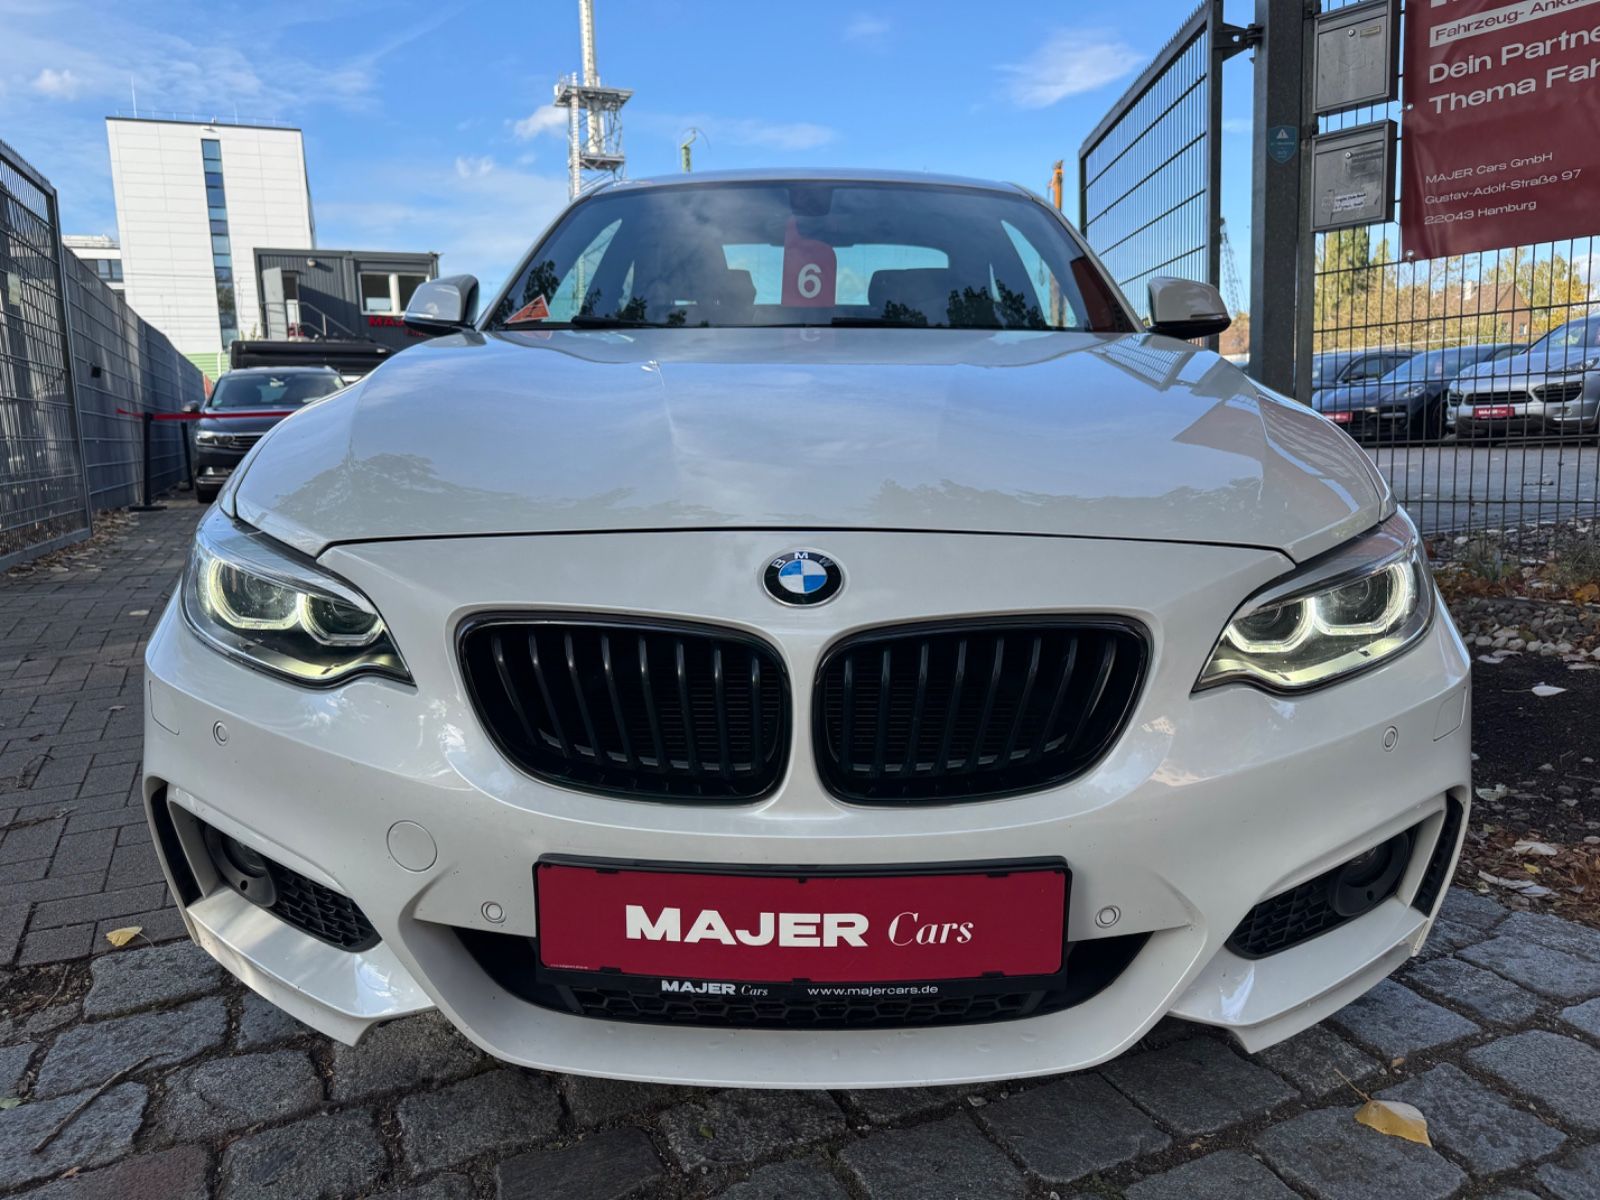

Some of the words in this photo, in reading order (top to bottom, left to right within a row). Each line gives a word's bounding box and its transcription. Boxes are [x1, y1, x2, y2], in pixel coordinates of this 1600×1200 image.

[1435, 11, 1525, 41] Fahrzeug-
[1429, 54, 1492, 84] Dein
[1428, 77, 1536, 114] Thema
[1425, 167, 1473, 184] MAJER
[1476, 161, 1507, 175] Cars
[1510, 151, 1553, 168] GmbH
[1424, 171, 1558, 205] Gustav-Adolf-Straße
[1561, 168, 1582, 181] 97
[1424, 209, 1474, 225] 22043
[1477, 200, 1537, 217] Hamburg
[797, 263, 822, 299] 6
[771, 551, 834, 569] BMW
[625, 904, 869, 947] MAJER
[887, 911, 974, 947] Cars
[661, 979, 736, 995] MAJER
[740, 984, 769, 997] Cars
[807, 984, 939, 997] www.majercars.de
